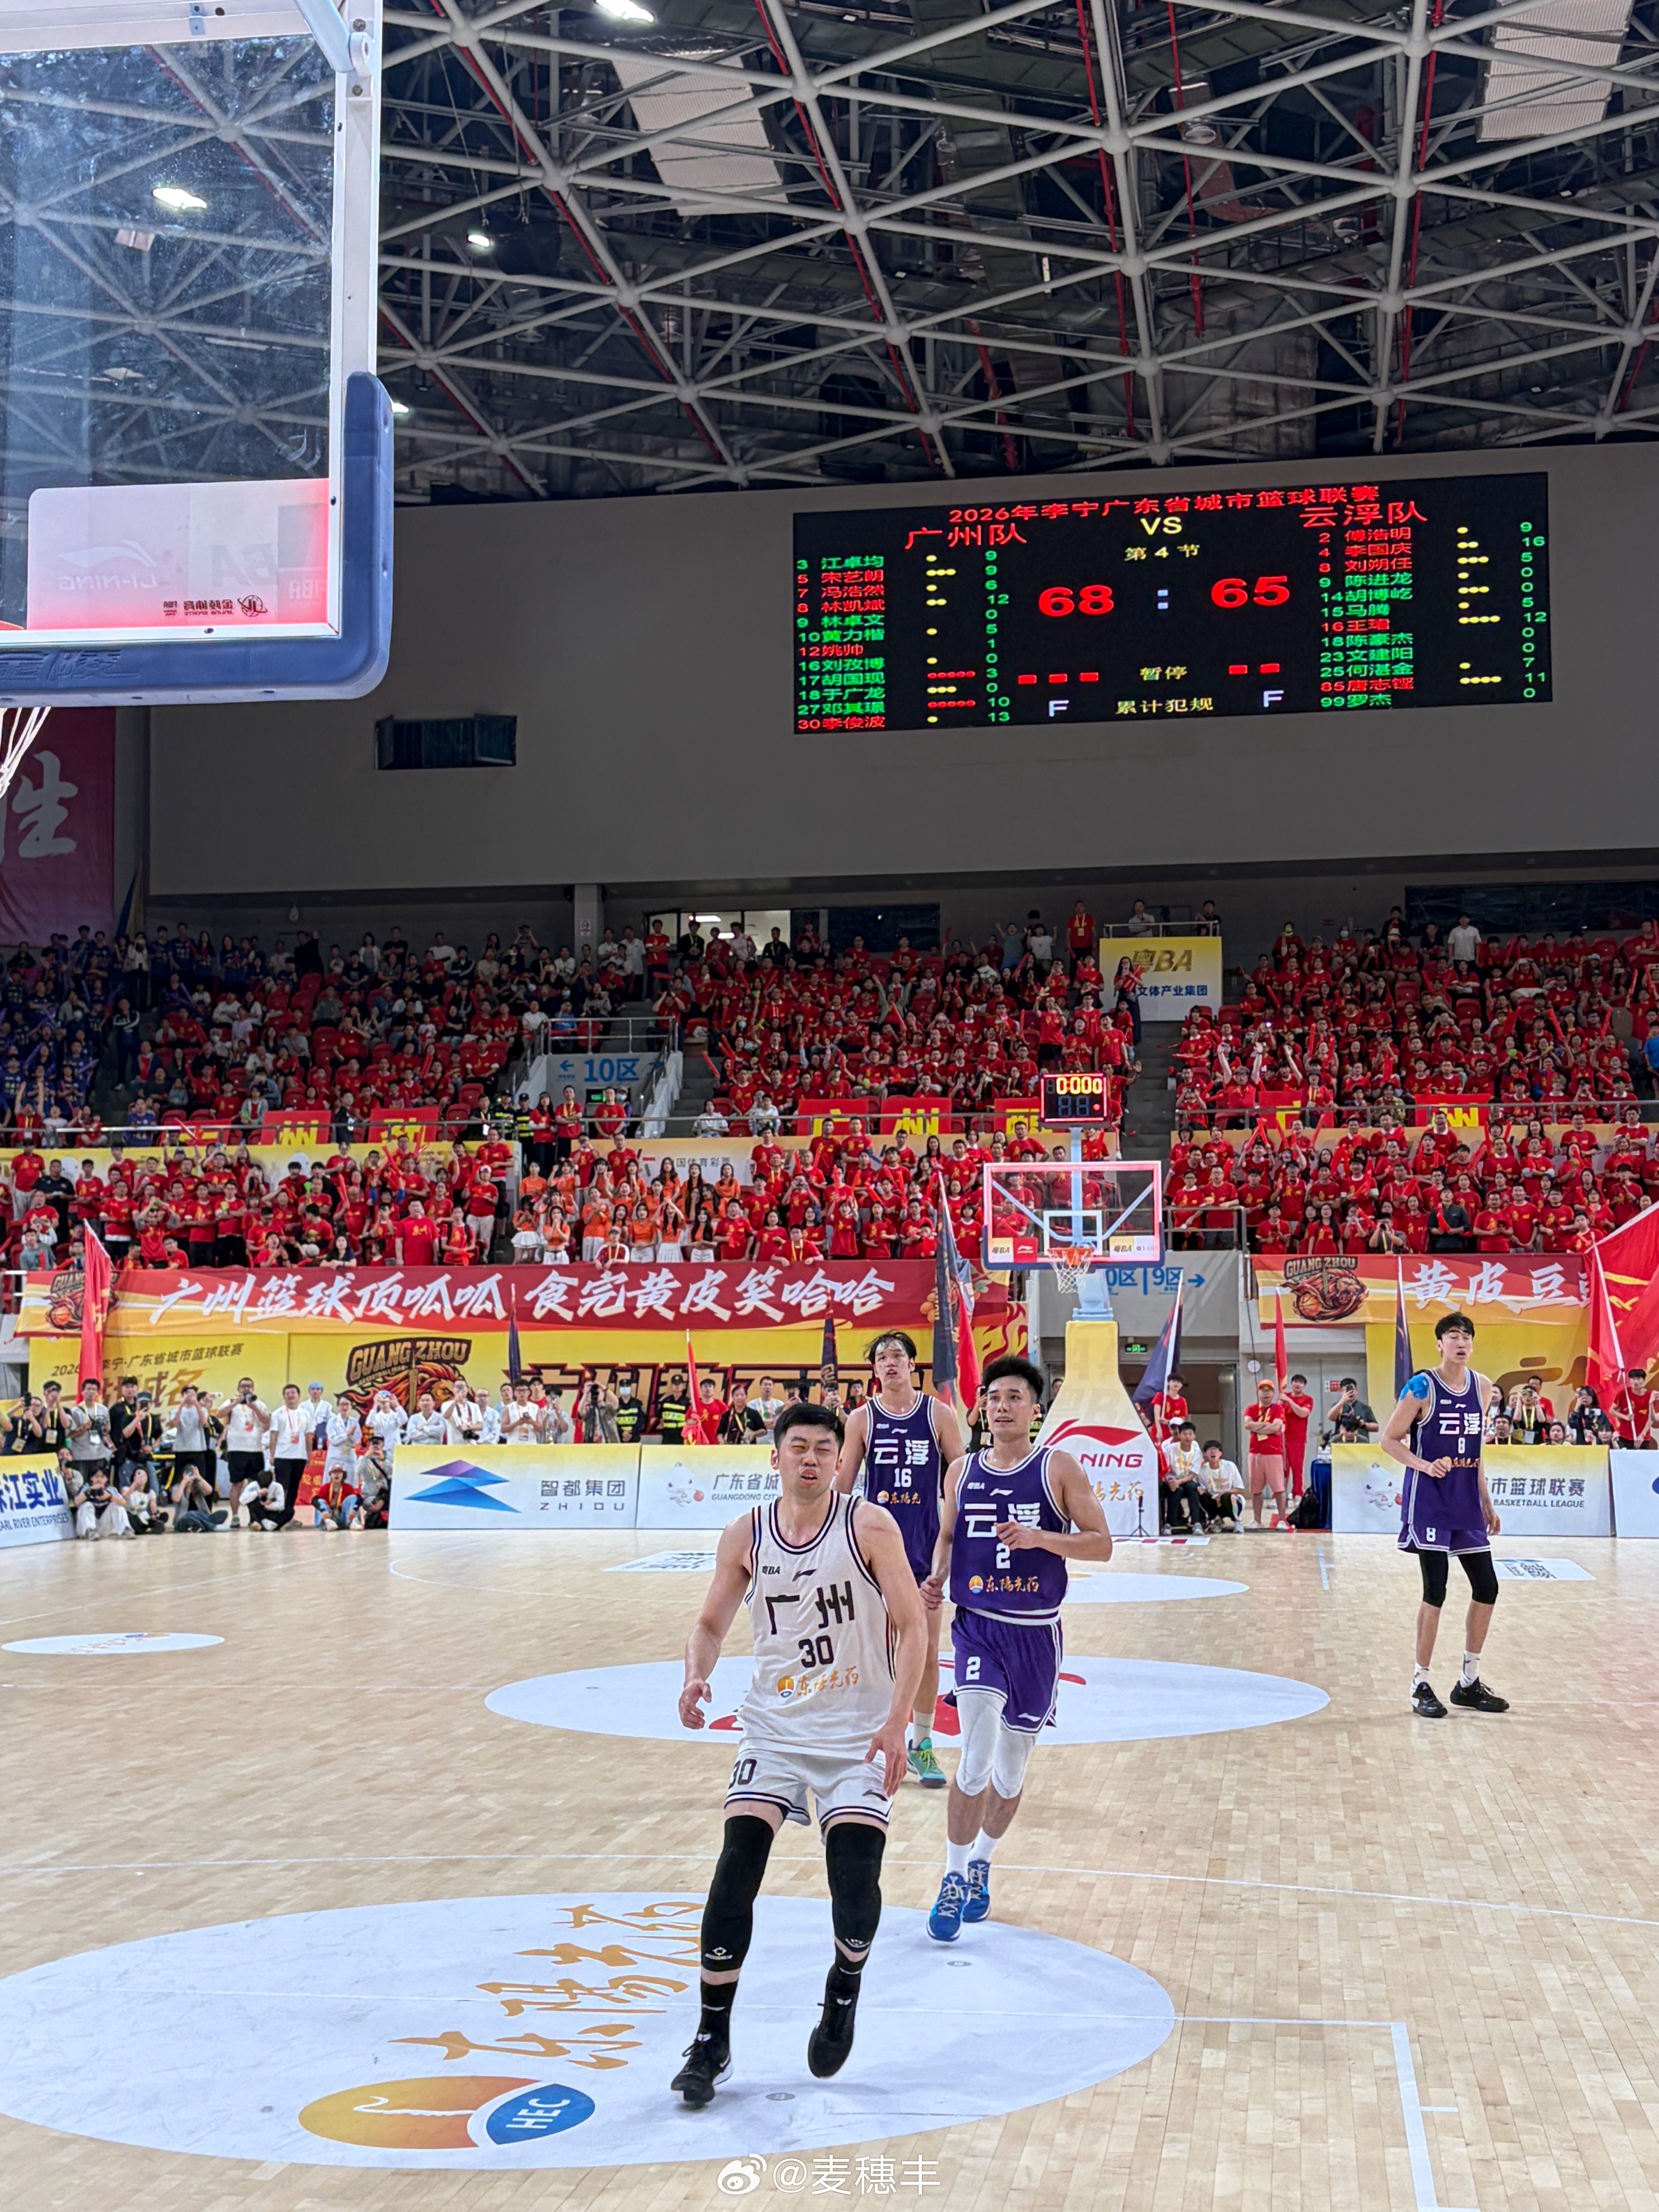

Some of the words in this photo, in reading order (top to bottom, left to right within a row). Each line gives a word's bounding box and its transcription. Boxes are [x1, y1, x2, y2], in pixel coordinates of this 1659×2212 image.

[949, 486, 1379, 523] 2026年李宁广东省城市篮球联赛
[1299, 501, 1428, 527] 云浮队
[1140, 517, 1182, 535] VS
[1319, 533, 1330, 543] 2
[1520, 522, 1532, 532] 9
[905, 523, 1027, 550] 广州队
[1319, 548, 1330, 558] 4
[1344, 543, 1412, 556] 李国庆
[1522, 537, 1545, 547] 16
[797, 560, 808, 569] 3
[821, 556, 884, 569] 江卓均
[985, 551, 997, 560] 9
[1319, 563, 1330, 573] 8
[1522, 552, 1532, 562] 5
[797, 574, 808, 584] 5
[821, 570, 884, 583] 宋艺朗
[985, 565, 998, 575] 9
[1319, 578, 1331, 587] 9
[1345, 573, 1412, 587] 陈进龙
[1521, 568, 1532, 577] 0
[797, 589, 808, 598] 7
[821, 584, 884, 598] 冯浩然
[985, 580, 998, 590] 6
[1038, 584, 1115, 618] 68
[1211, 575, 1290, 609] 65
[1321, 592, 1343, 602] 14
[1522, 582, 1533, 592] 0
[797, 603, 808, 613] 8
[988, 594, 1009, 604] 12
[1321, 608, 1343, 617] 15
[1522, 598, 1533, 608] 5
[797, 618, 808, 627] 9
[821, 614, 884, 627] 林卓文
[986, 610, 998, 619] 0
[1321, 622, 1344, 631] 16
[1523, 612, 1546, 622] 12
[799, 633, 820, 642] 10
[986, 624, 998, 634] 5
[1321, 637, 1344, 646] 18
[1522, 627, 1534, 637] 0
[799, 647, 820, 656] 12
[822, 644, 864, 656] 姚帅
[988, 639, 996, 648] 1
[1320, 652, 1344, 662] 23
[1346, 648, 1413, 662] 文建阳
[1522, 643, 1534, 652] 0
[799, 661, 820, 671] 16
[986, 654, 998, 663] 0
[1320, 667, 1344, 677] 25
[1523, 658, 1535, 667] 7
[799, 676, 820, 686] 17
[822, 672, 885, 686] 胡国现
[986, 668, 998, 678] 3
[1139, 666, 1187, 681] 暂停
[1321, 682, 1344, 691] 85
[1526, 673, 1545, 682] 11
[799, 690, 820, 700] 18
[822, 687, 885, 700] 于广龙
[986, 683, 998, 693] 0
[1262, 690, 1285, 708] F
[1321, 697, 1344, 707] 99
[1347, 694, 1391, 707] 罗杰
[1523, 688, 1535, 697] 0
[797, 705, 820, 715] 27
[988, 697, 1010, 707] 10
[1049, 700, 1069, 717] F
[1115, 697, 1214, 715] 累计犯规
[798, 720, 820, 729] 30
[822, 716, 885, 729] 李俊波
[988, 712, 1010, 722] 13
[1137, 985, 1207, 996] 文体产业集团
[584, 1058, 639, 1082] 10区
[673, 1156, 731, 1168] 国体育彩票
[53, 1273, 86, 1289] GUAN
[149, 1271, 507, 1325] 广州篮球顶呱呱
[524, 1266, 895, 1322] 食完黄皮笑哈哈
[51, 1343, 244, 1377] 2026李宁·广东省城市篮球联赛
[350, 1342, 412, 1381] GUANG
[414, 1341, 467, 1361] ZHOU
[1439, 1412, 1481, 1435] 云浮
[874, 1439, 929, 1465] 云浮
[1458, 1437, 1466, 1454] 8
[894, 1468, 912, 1487] 16
[1486, 1477, 1585, 1497] 市篮球联赛
[540, 1479, 626, 1497] 智都集团
[711, 1492, 761, 1501] GUANGDONG
[1493, 1498, 1549, 1507] BASKETBALL
[1550, 1499, 1585, 1508] LEAGUE
[0, 1519, 13, 1531] ARL
[13, 1516, 30, 1528] RIVER
[964, 1502, 1042, 1538] 云浮
[1426, 1527, 1436, 1542] 8
[996, 1542, 1011, 1569] 2
[765, 1580, 855, 1635] 广州
[798, 1635, 834, 1668] 30
[965, 1656, 981, 1681] 2
[506, 2098, 571, 2130] HEC
